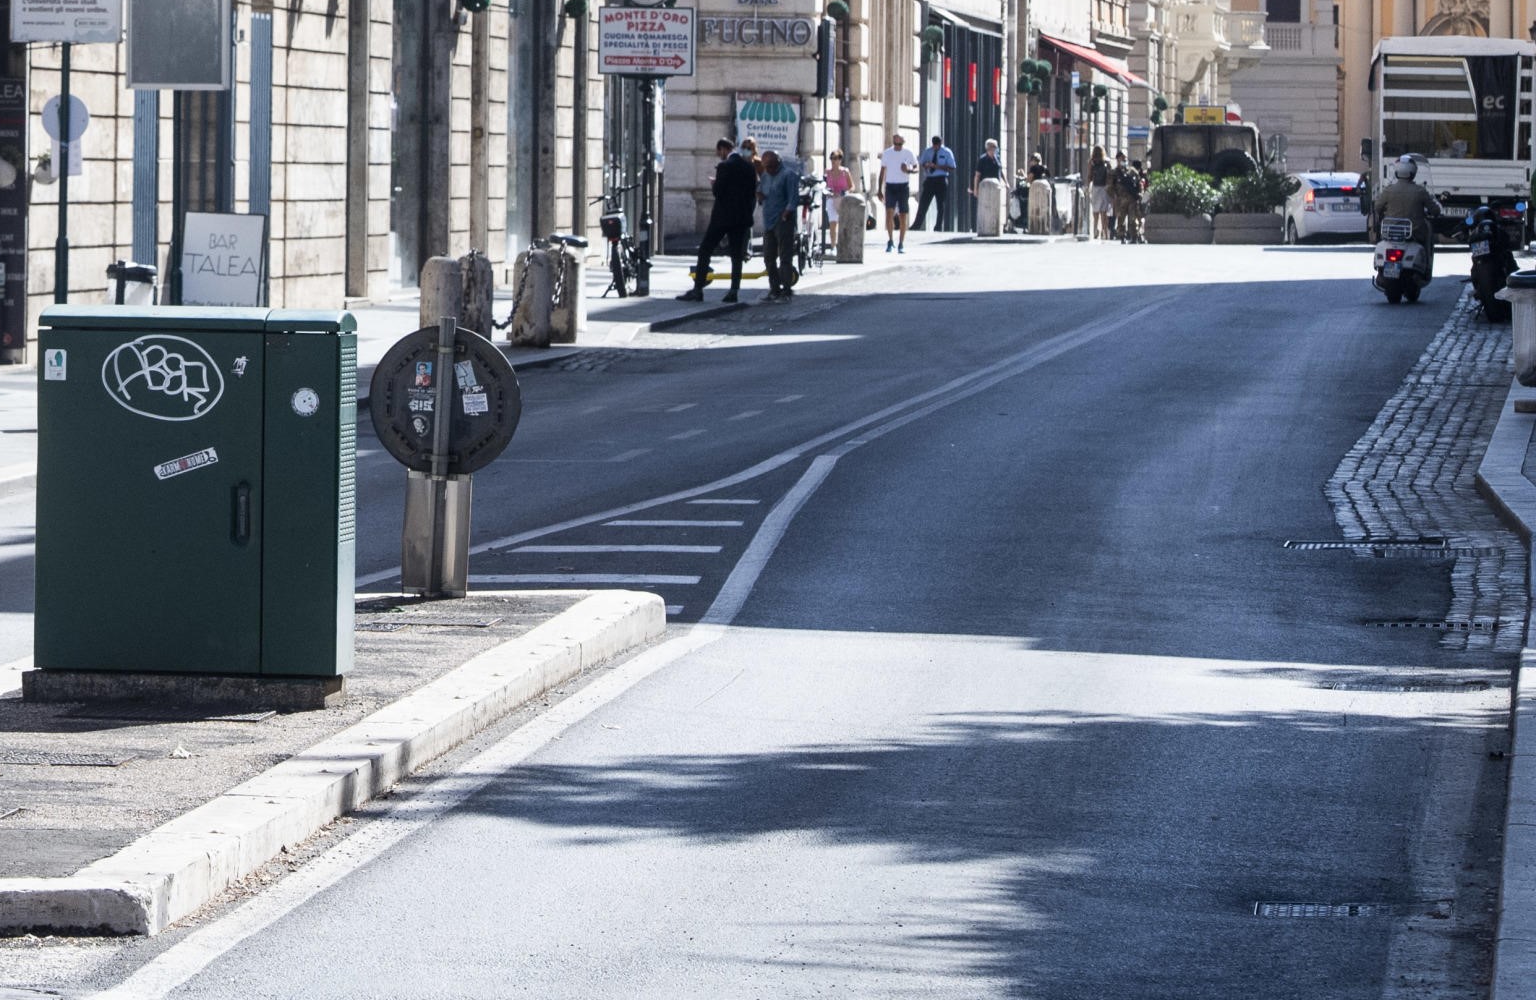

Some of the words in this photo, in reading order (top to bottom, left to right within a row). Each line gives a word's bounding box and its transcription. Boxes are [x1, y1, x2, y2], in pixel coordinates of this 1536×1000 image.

[605, 11, 647, 24] MONTE
[650, 11, 688, 24] D'ORO
[627, 22, 666, 32] PIZZA
[700, 18, 812, 46] FUCINO
[747, 123, 788, 132] Certificati
[758, 132, 787, 140] edicola
[209, 233, 238, 250] BAR
[184, 252, 257, 277] TALEA
